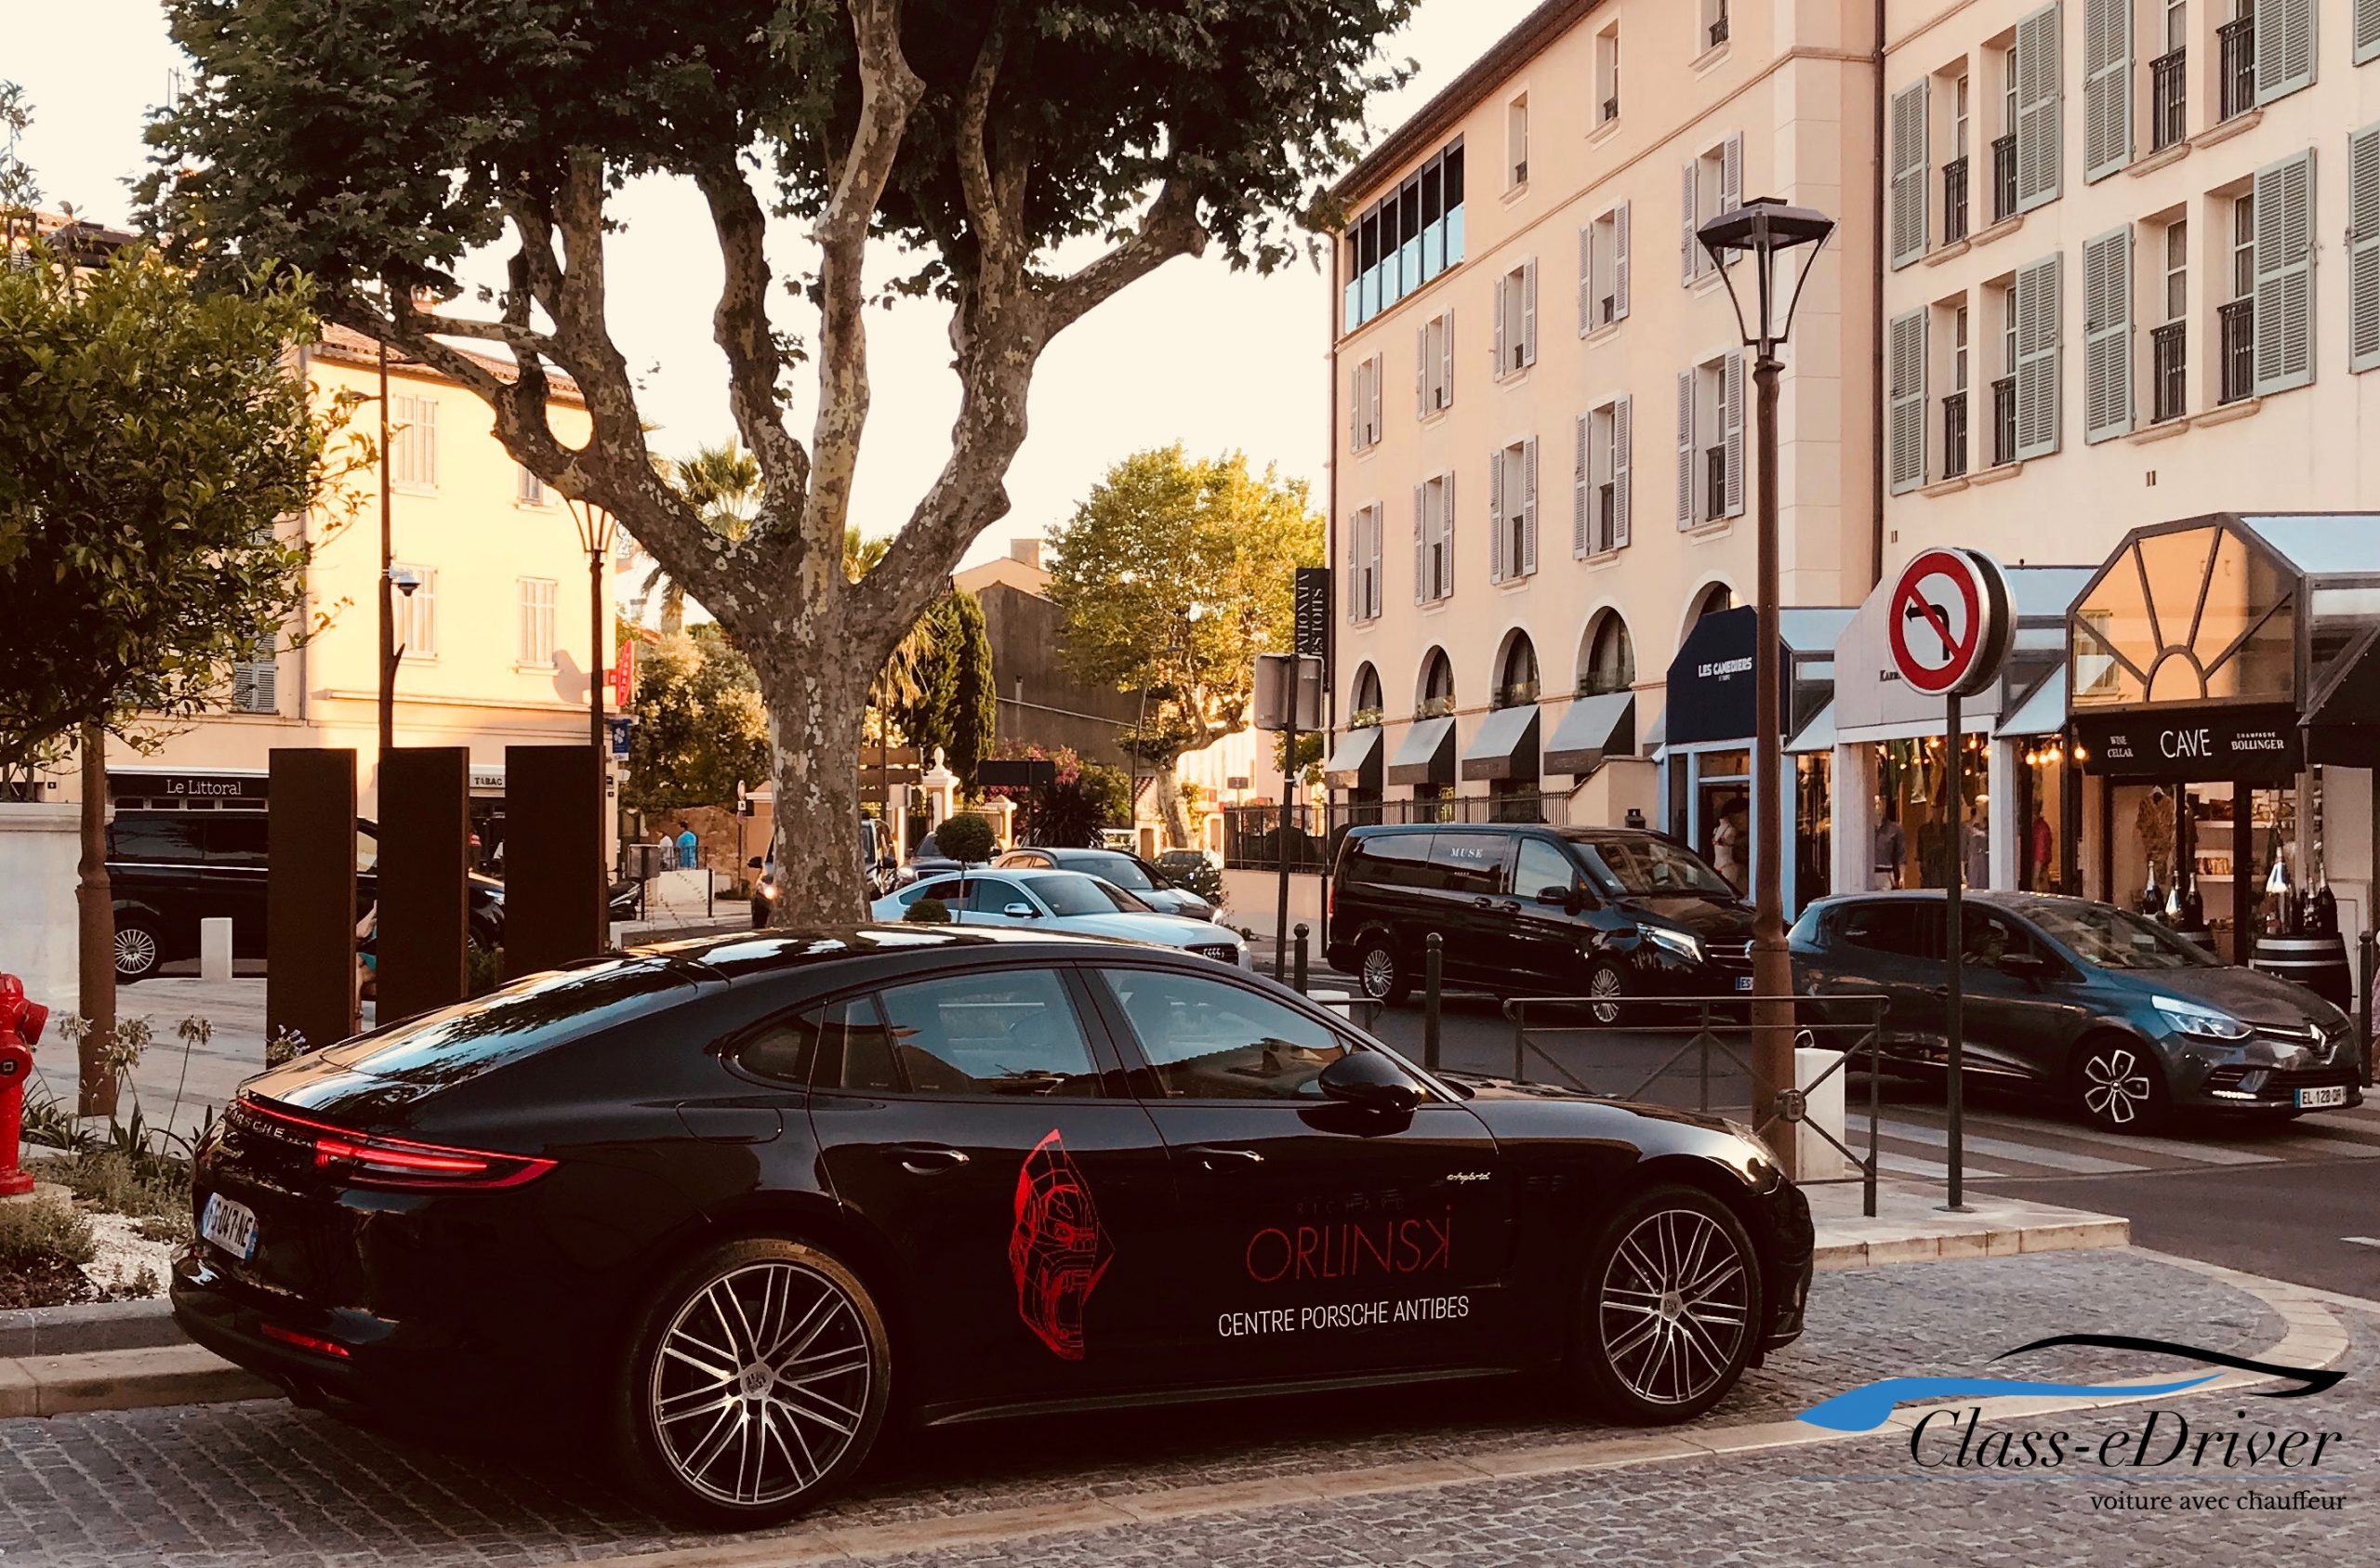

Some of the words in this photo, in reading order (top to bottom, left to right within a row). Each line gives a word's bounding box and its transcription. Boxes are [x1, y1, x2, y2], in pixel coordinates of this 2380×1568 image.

[1311, 587, 1324, 633] TOITS
[1698, 664, 1712, 679] LES
[2109, 735, 2128, 745] WINE
[2160, 729, 2213, 758] CAVE
[2231, 739, 2284, 750] BOLLINGER
[2107, 747, 2135, 758] CELLAR
[166, 779, 185, 794] Le
[188, 780, 243, 796] Littoral
[474, 777, 503, 786] TABAC
[1450, 847, 1484, 859] MUSE
[1218, 1309, 1295, 1337] CENTRE
[1302, 1301, 1389, 1330] PORSCHE
[1394, 1295, 1470, 1324] ANTIBES
